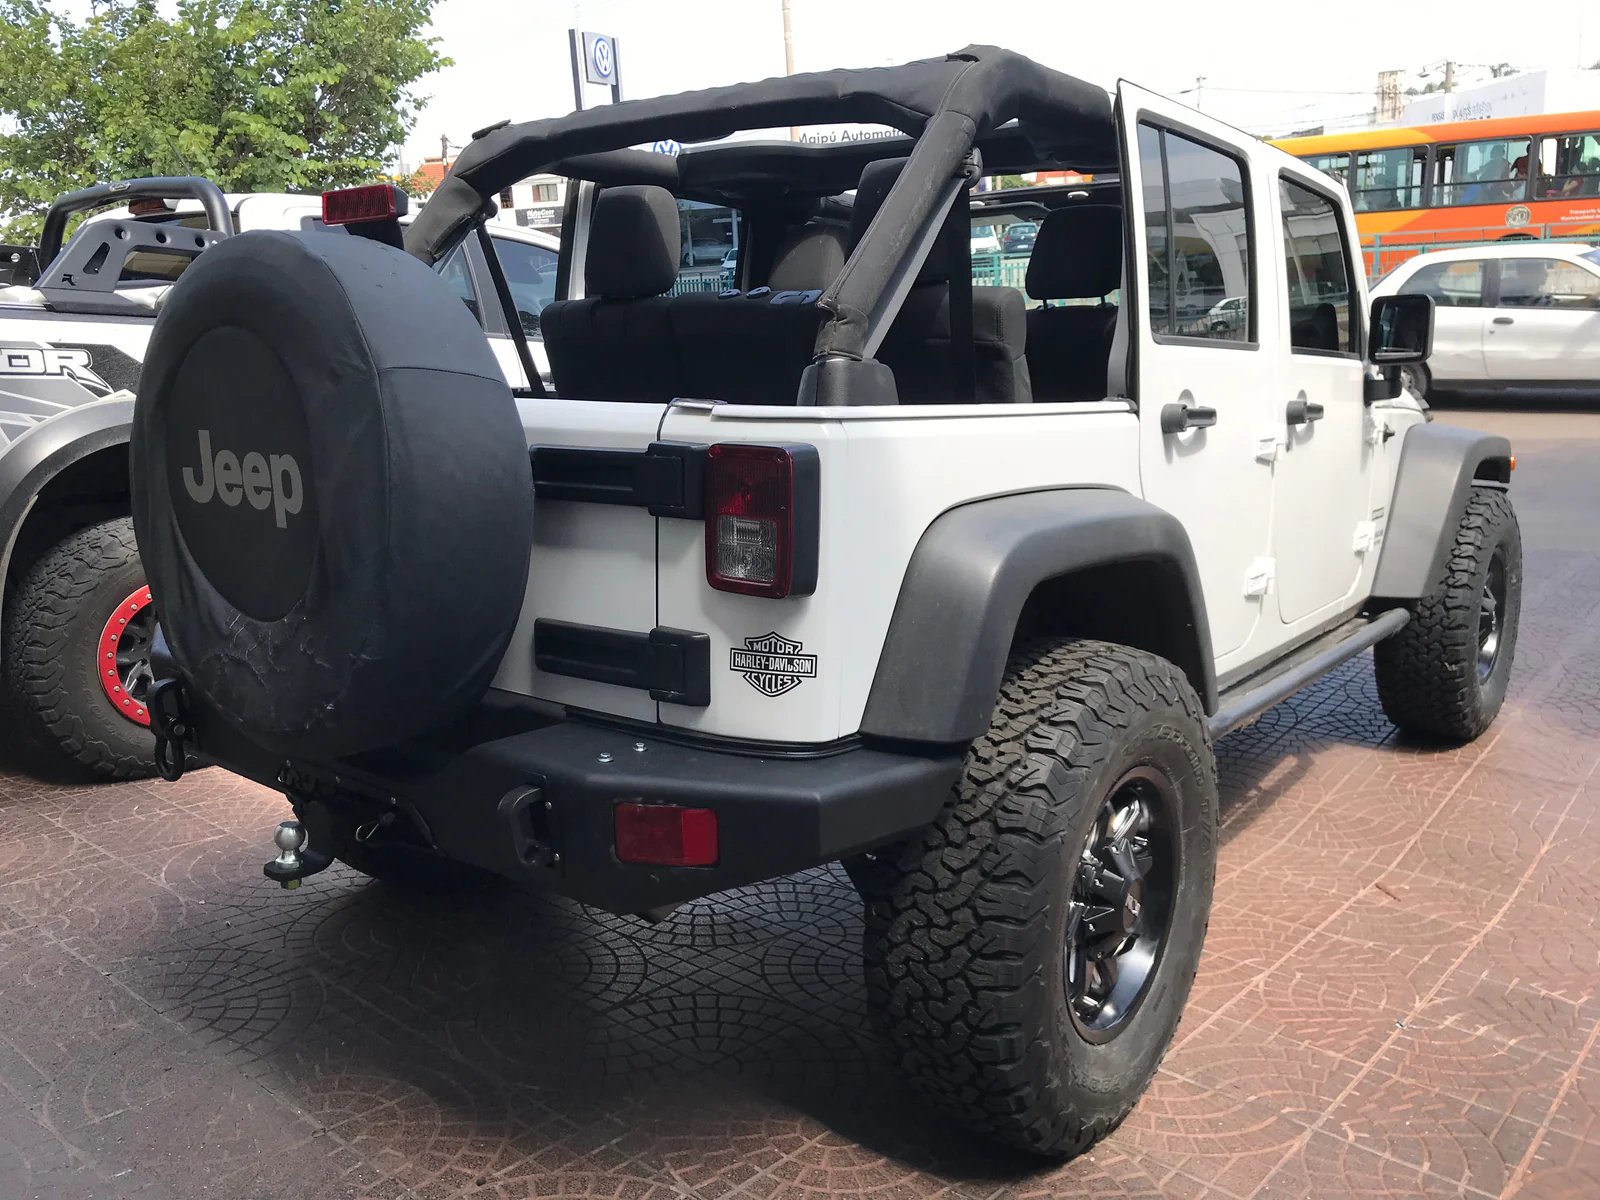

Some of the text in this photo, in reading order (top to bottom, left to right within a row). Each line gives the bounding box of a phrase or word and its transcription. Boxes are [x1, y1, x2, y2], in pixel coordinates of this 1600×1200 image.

[799, 131, 836, 143] Maipú
[182, 429, 303, 529] Jeep
[752, 638, 795, 655] MOTOR
[735, 653, 812, 673] HARLEY-DAVIDSON
[751, 672, 793, 692] CYCLES
